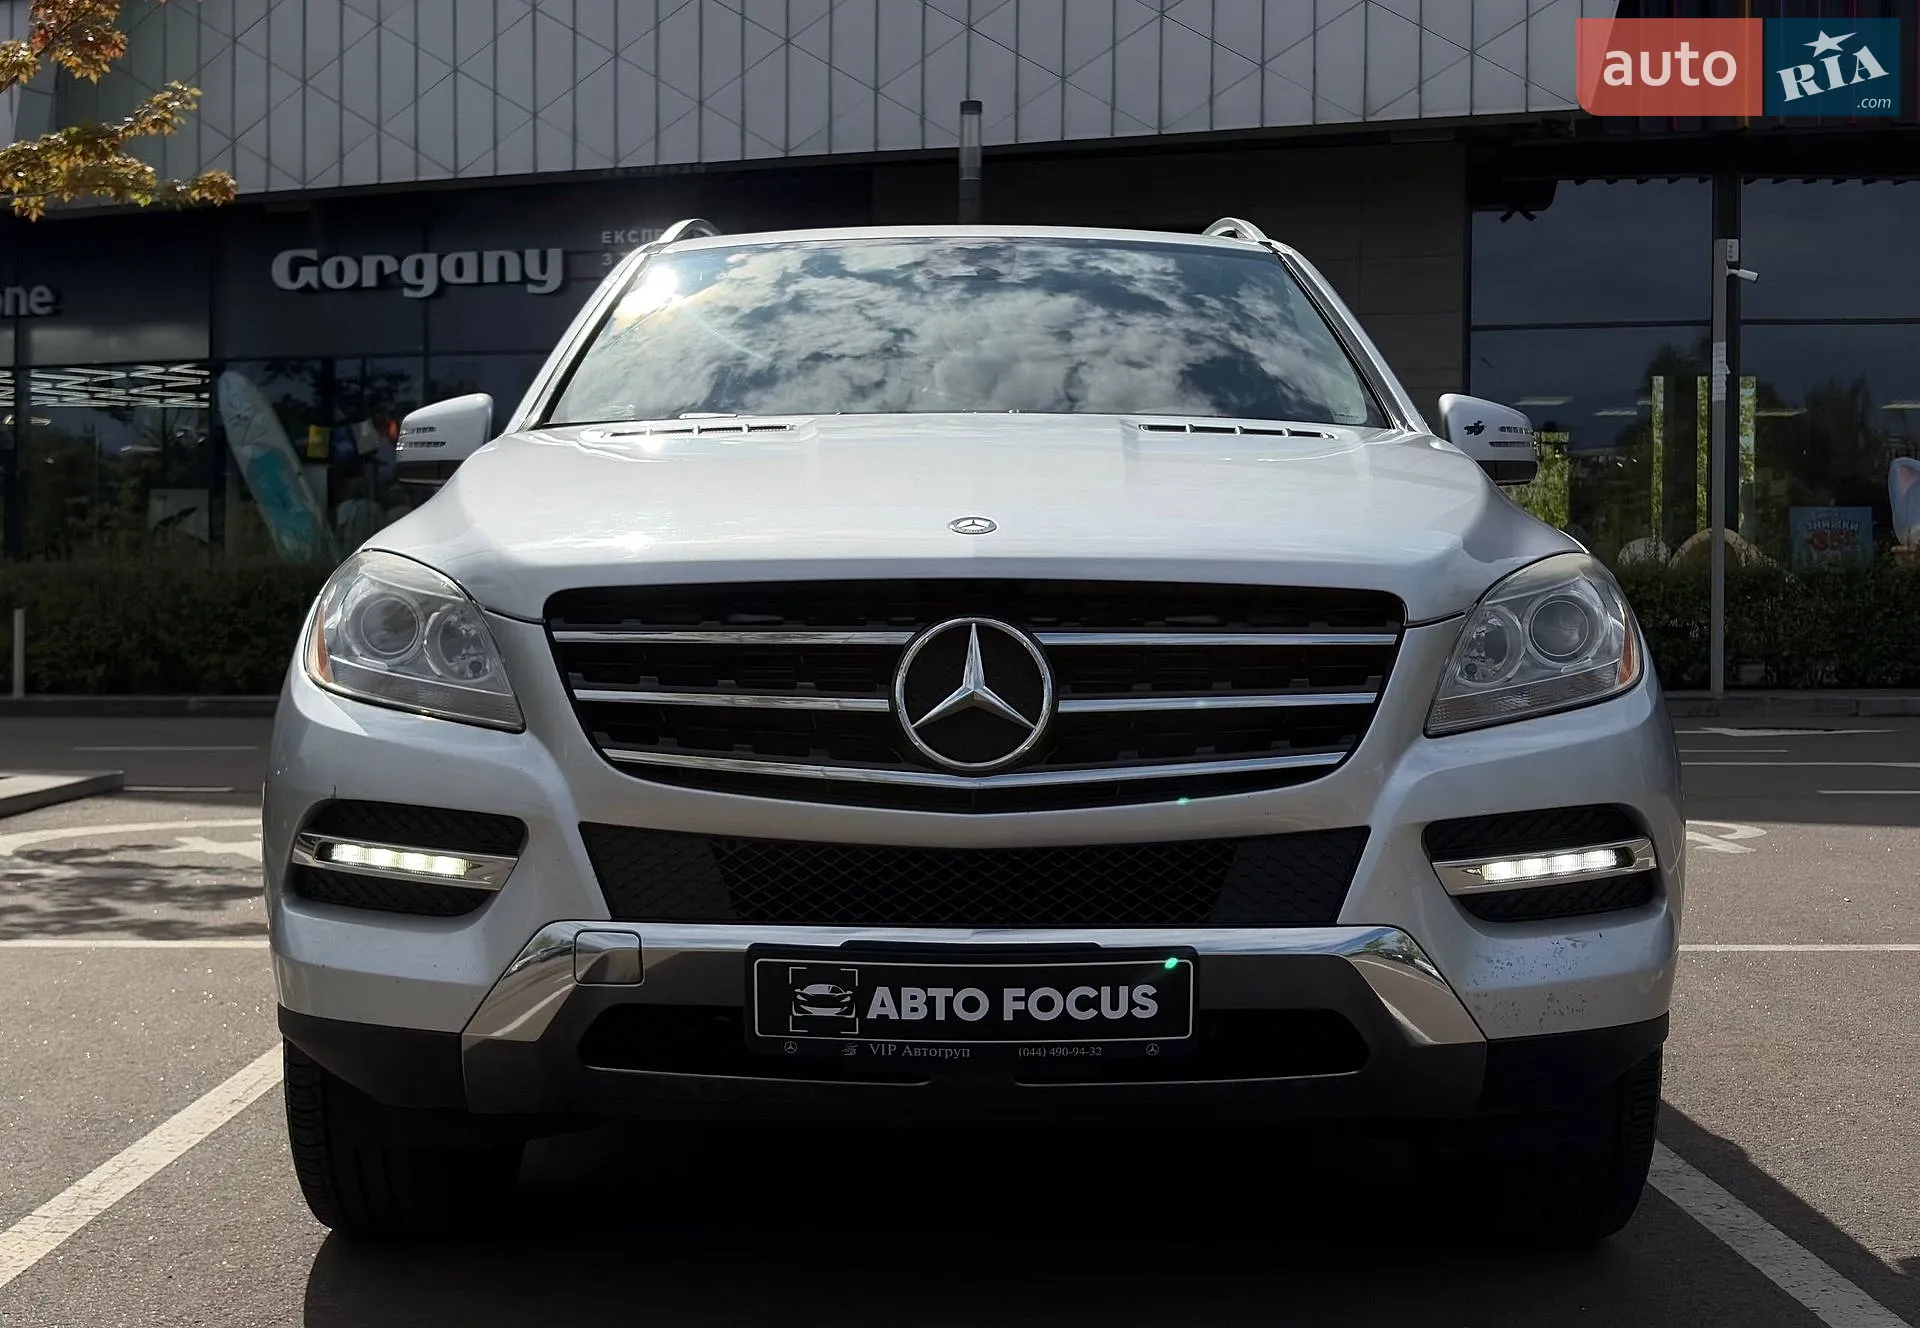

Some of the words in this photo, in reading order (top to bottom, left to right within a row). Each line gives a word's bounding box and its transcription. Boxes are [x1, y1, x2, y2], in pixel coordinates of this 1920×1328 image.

[272, 248, 563, 297] Gorgany
[0, 284, 56, 316] ne
[867, 986, 990, 1021] АВТО
[1003, 985, 1158, 1021] FOCUS
[869, 1044, 897, 1056] VIP
[901, 1045, 970, 1058] Автогруп
[1018, 1047, 1046, 1057] (044)
[1049, 1047, 1103, 1057] 490-94-32
